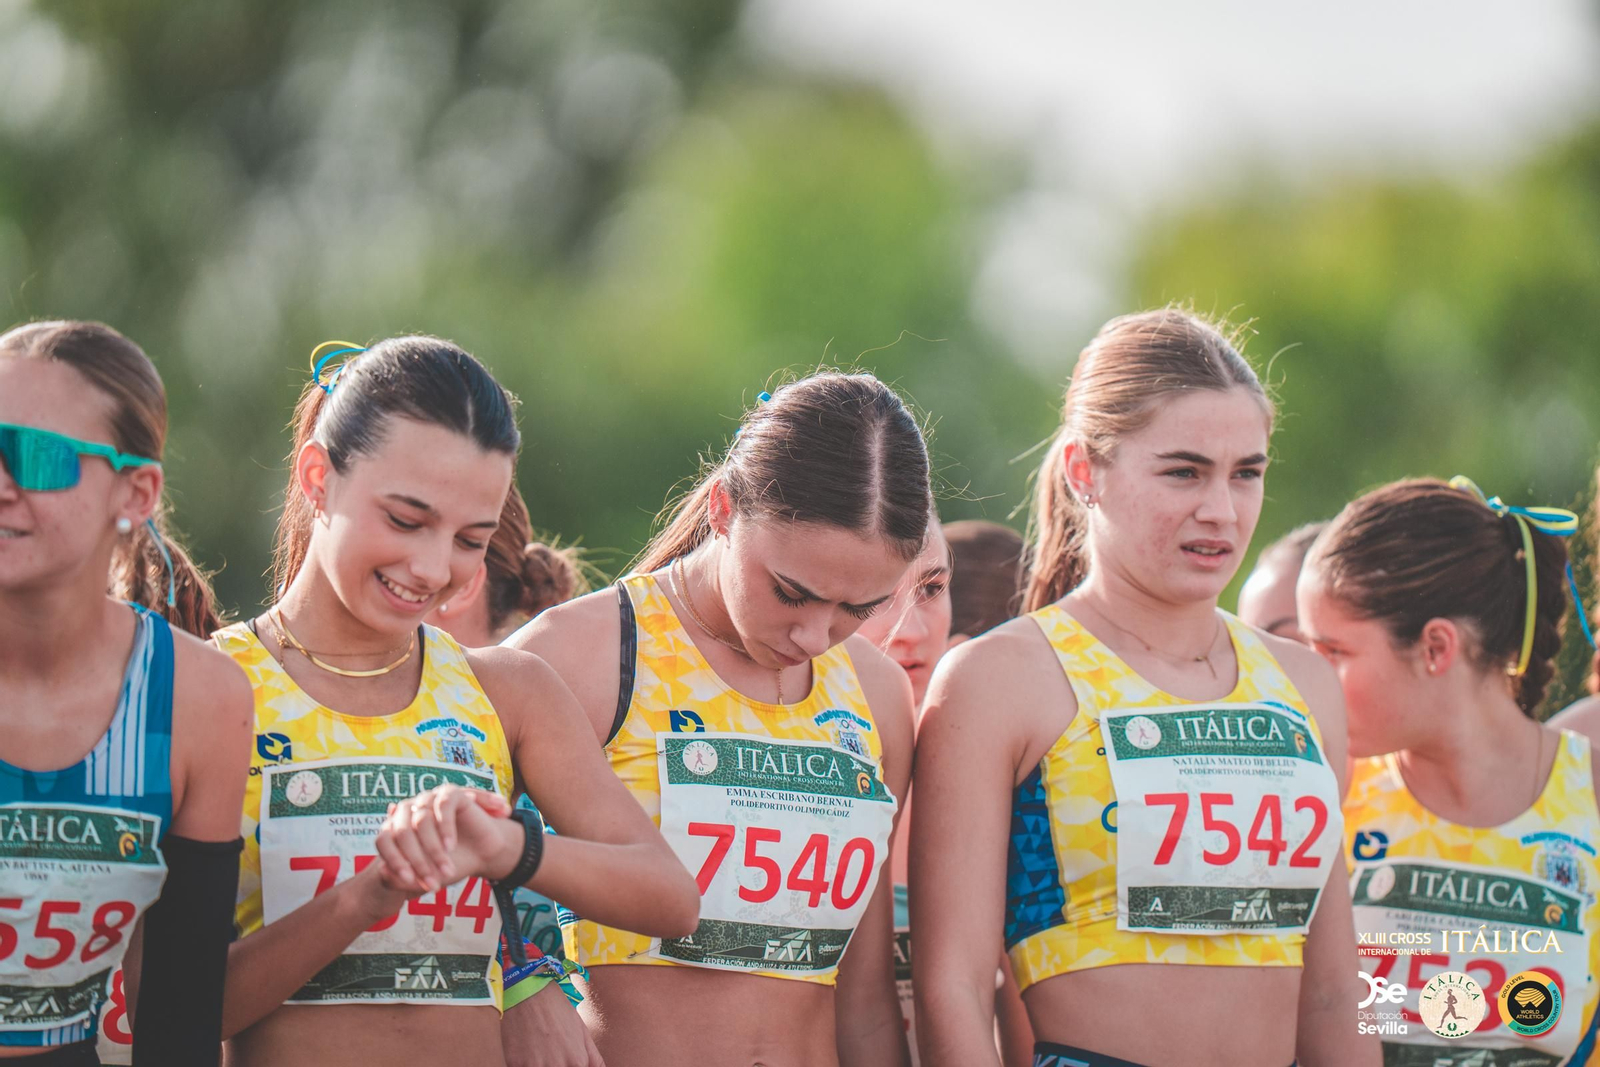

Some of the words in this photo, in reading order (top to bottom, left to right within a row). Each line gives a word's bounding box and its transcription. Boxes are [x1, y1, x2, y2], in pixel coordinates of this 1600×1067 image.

[1175, 710, 1285, 741] ITÁLICA
[735, 745, 844, 780] ITÁLICA
[1178, 768, 1241, 776] POLIDEPORTIVO
[1241, 768, 1272, 777] OLIMPO
[1218, 757, 1252, 767] MATEO
[738, 771, 791, 782] INTERNATIONAL
[792, 776, 814, 784] CROSS
[726, 788, 758, 799] EMMA
[760, 790, 814, 804] ESCRIBANO
[816, 796, 854, 808] BERNAL
[730, 799, 793, 812] POLIDEPORTIVO
[794, 806, 825, 816] OLIMPO
[826, 808, 850, 818] CÁDIZ
[1144, 792, 1329, 869] 7542
[688, 821, 876, 910] 7540
[1409, 869, 1529, 910] ITÁLICA
[764, 939, 812, 962] FAA
[703, 957, 745, 968] FEDERACIÓN
[395, 967, 448, 989] FAA
